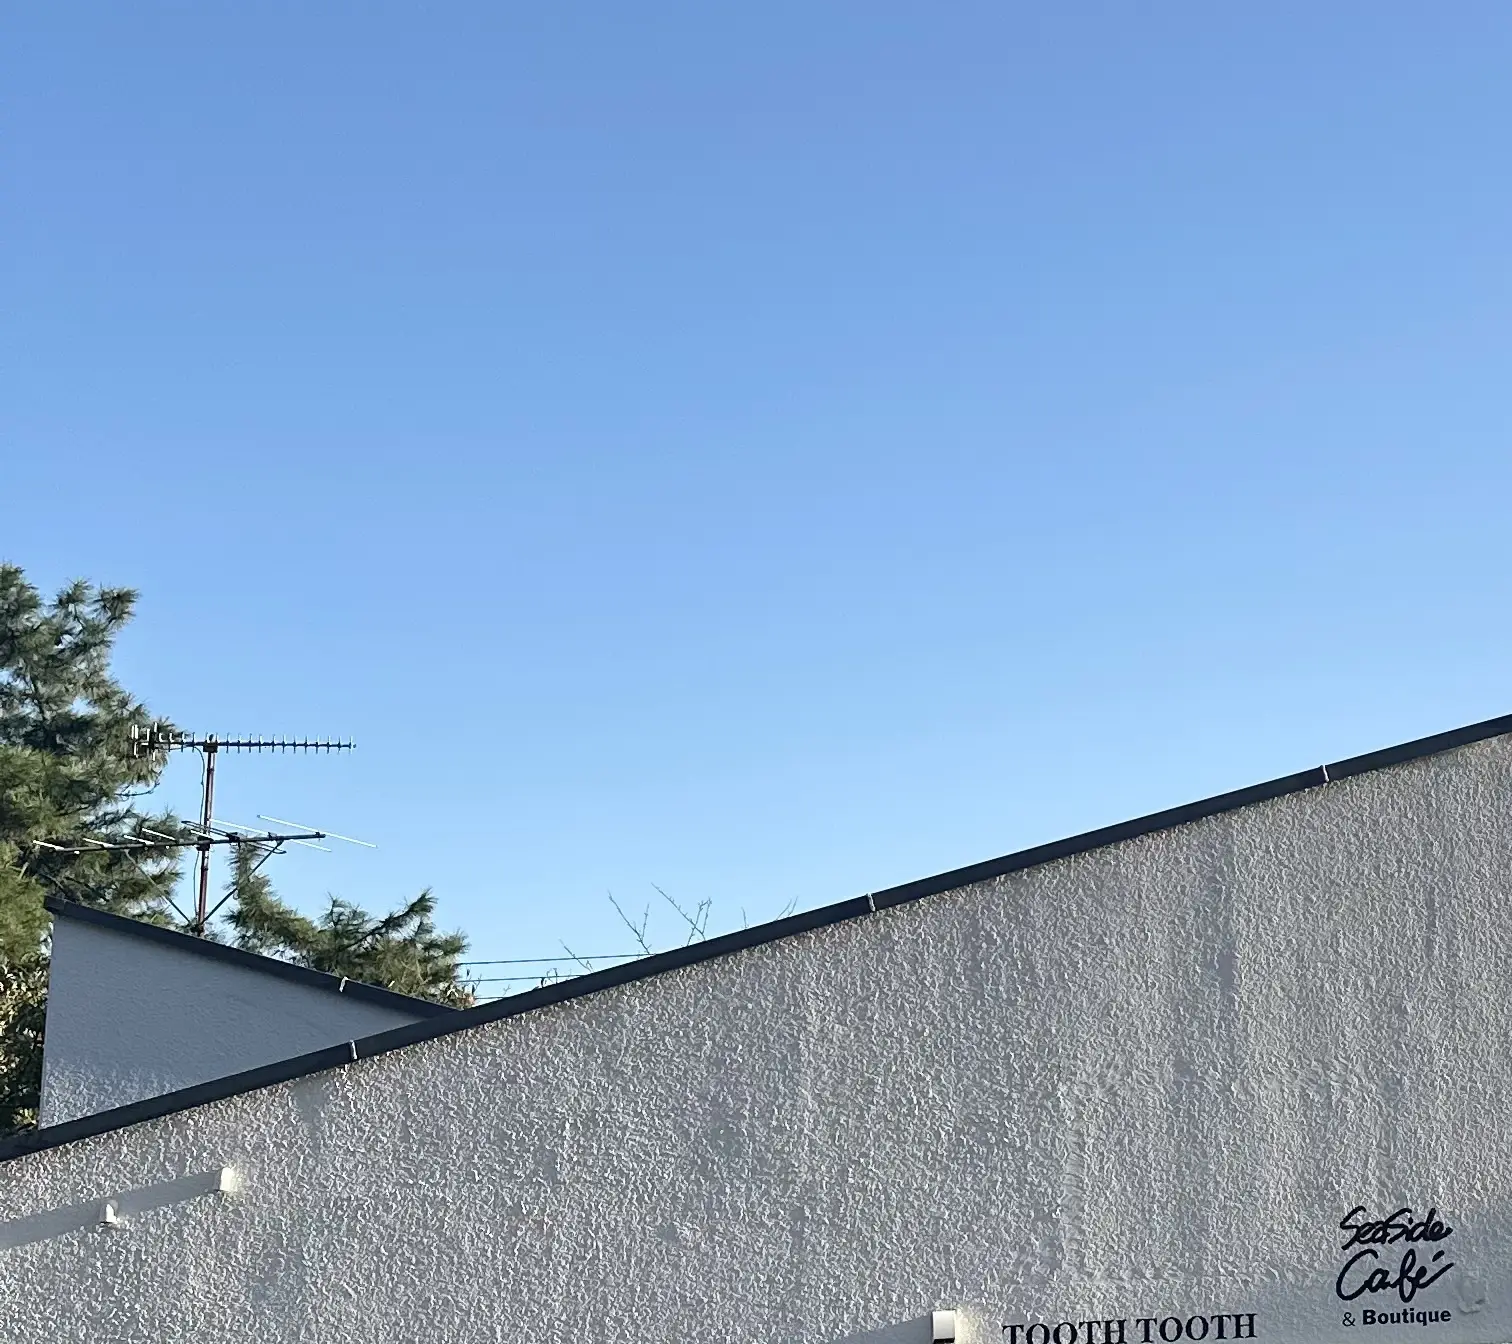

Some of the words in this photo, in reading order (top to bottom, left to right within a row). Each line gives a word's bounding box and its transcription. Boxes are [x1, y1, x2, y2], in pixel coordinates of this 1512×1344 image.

[1336, 1248, 1454, 1302] Café
[1136, 1313, 1258, 1344] TOOTH
[1342, 1312, 1356, 1327] &
[1362, 1308, 1451, 1327] Boutique
